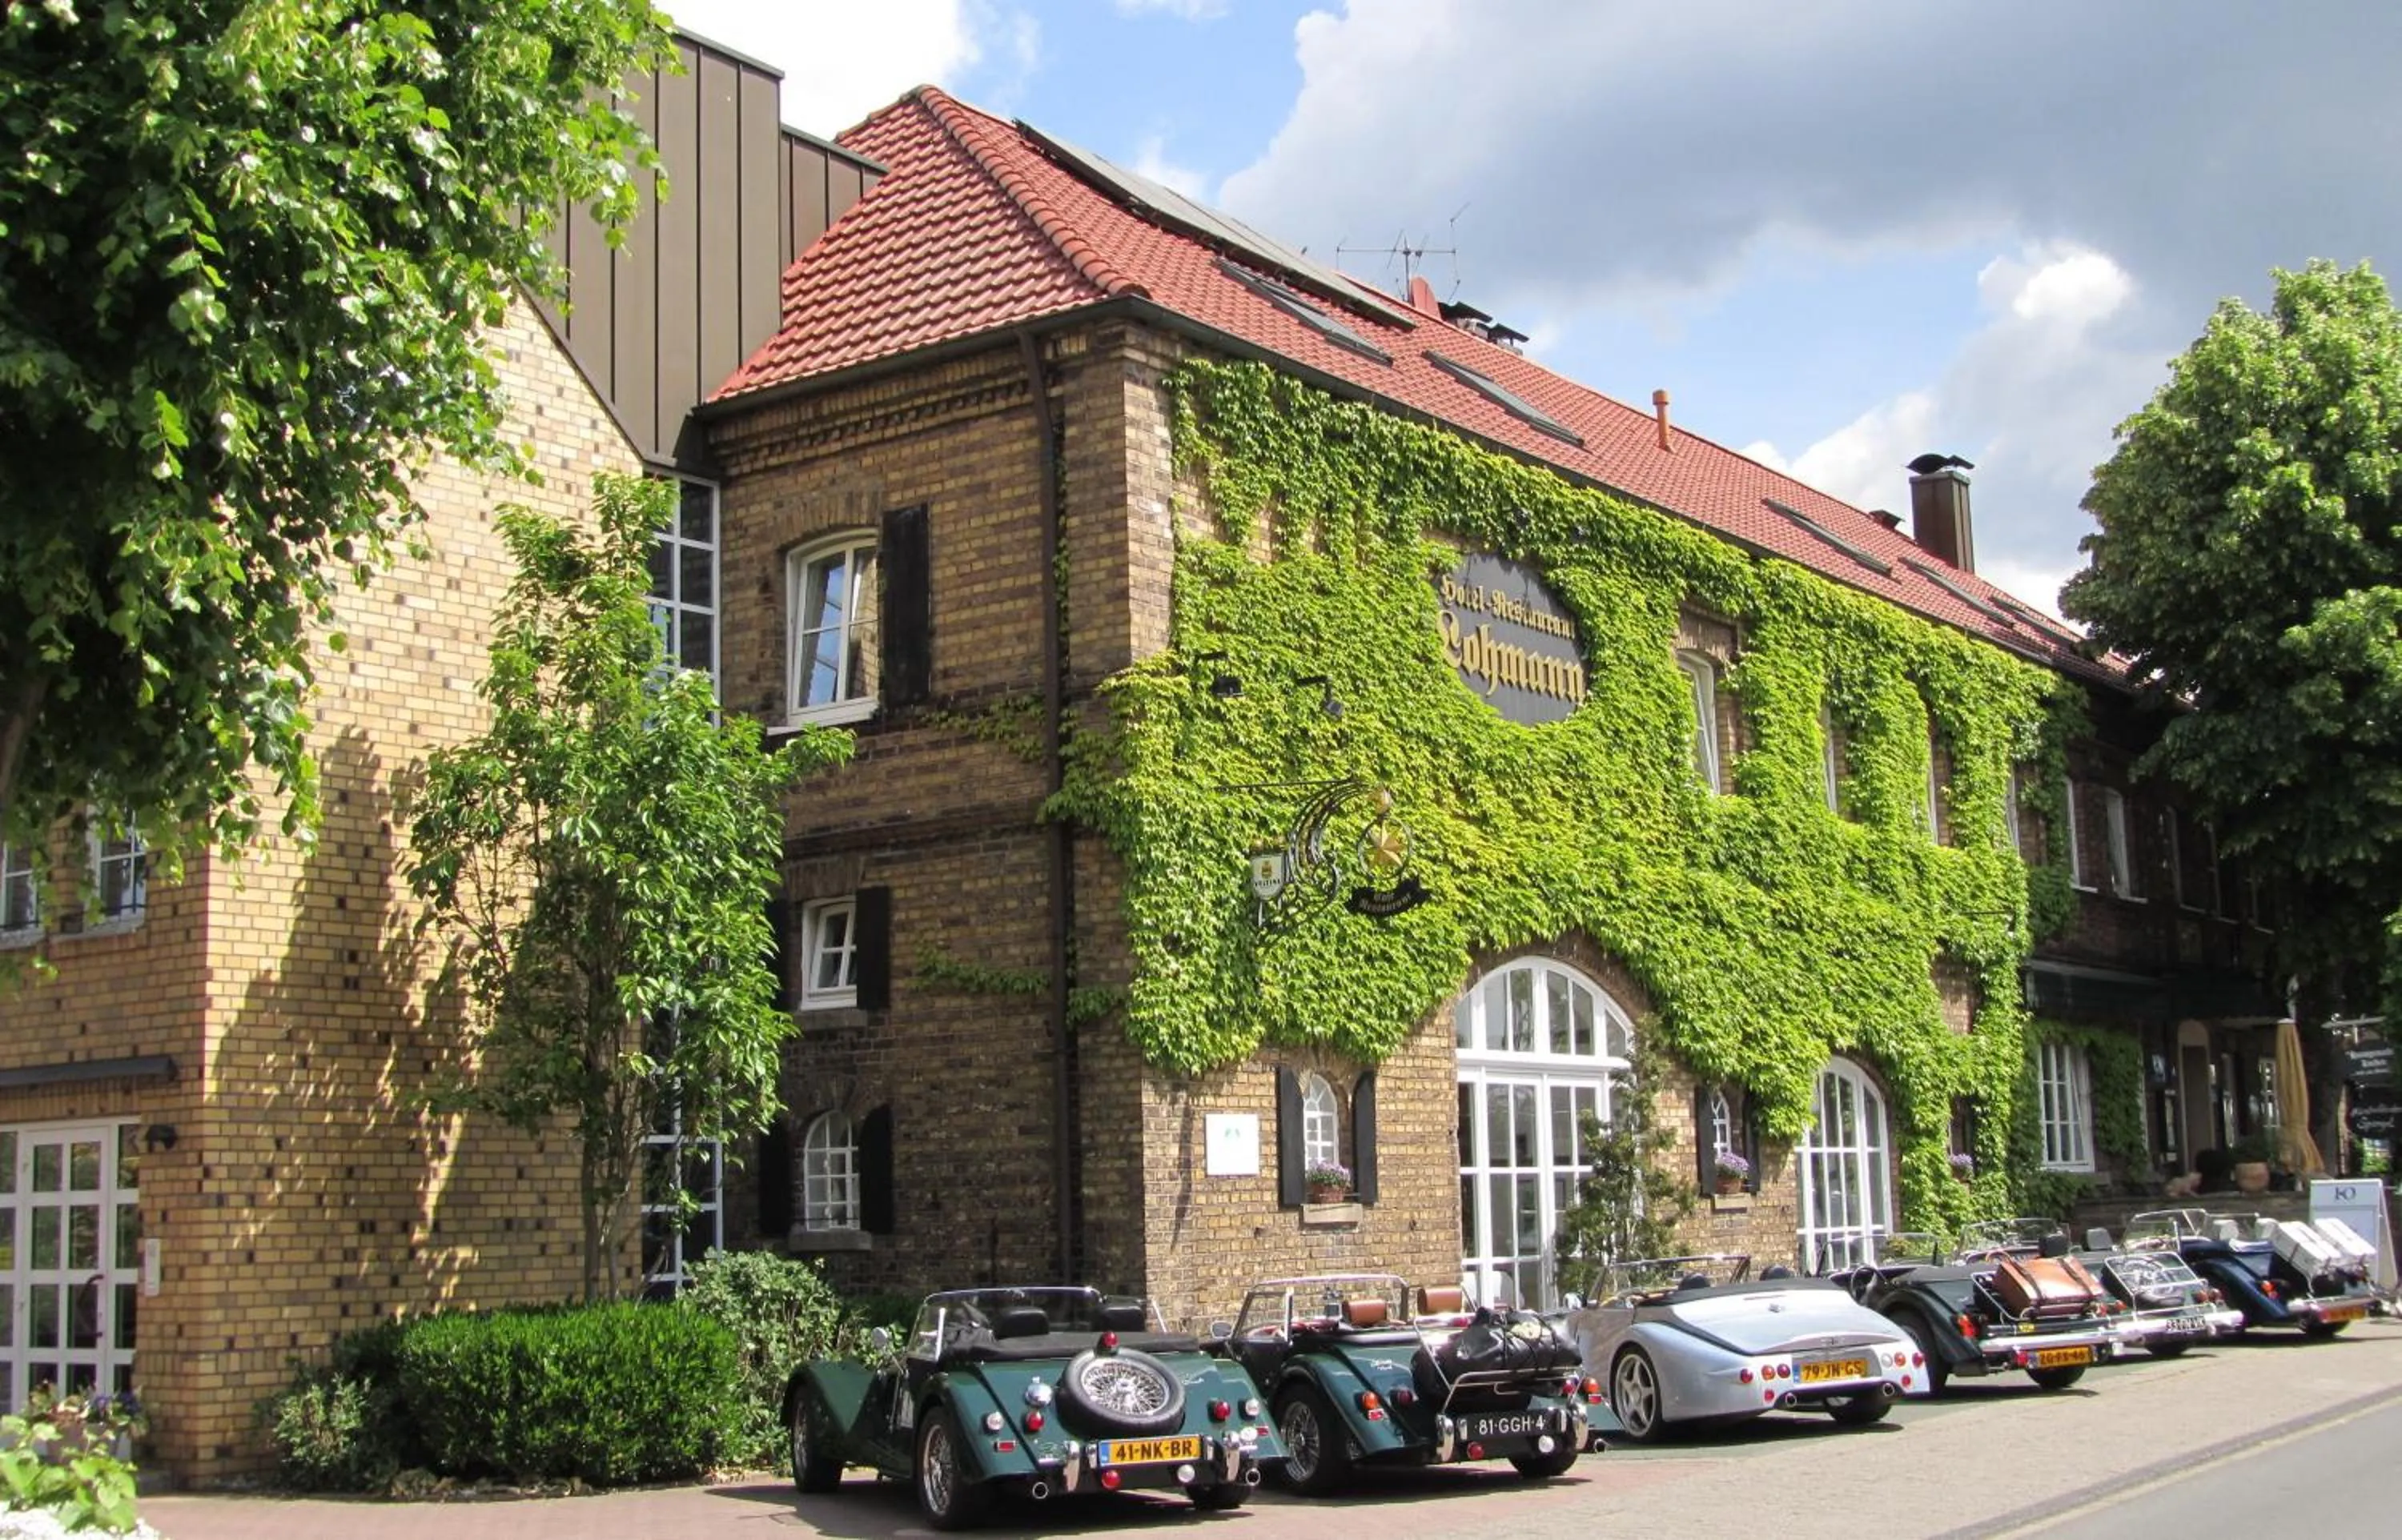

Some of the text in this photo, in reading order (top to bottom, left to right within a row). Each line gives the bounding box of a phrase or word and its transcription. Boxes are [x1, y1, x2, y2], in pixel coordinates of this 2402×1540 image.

[1440, 574, 1576, 639] Hotel-Restaurant
[1436, 610, 1586, 703] Lohmann
[1116, 1440, 1192, 1461] 41-NK-BR
